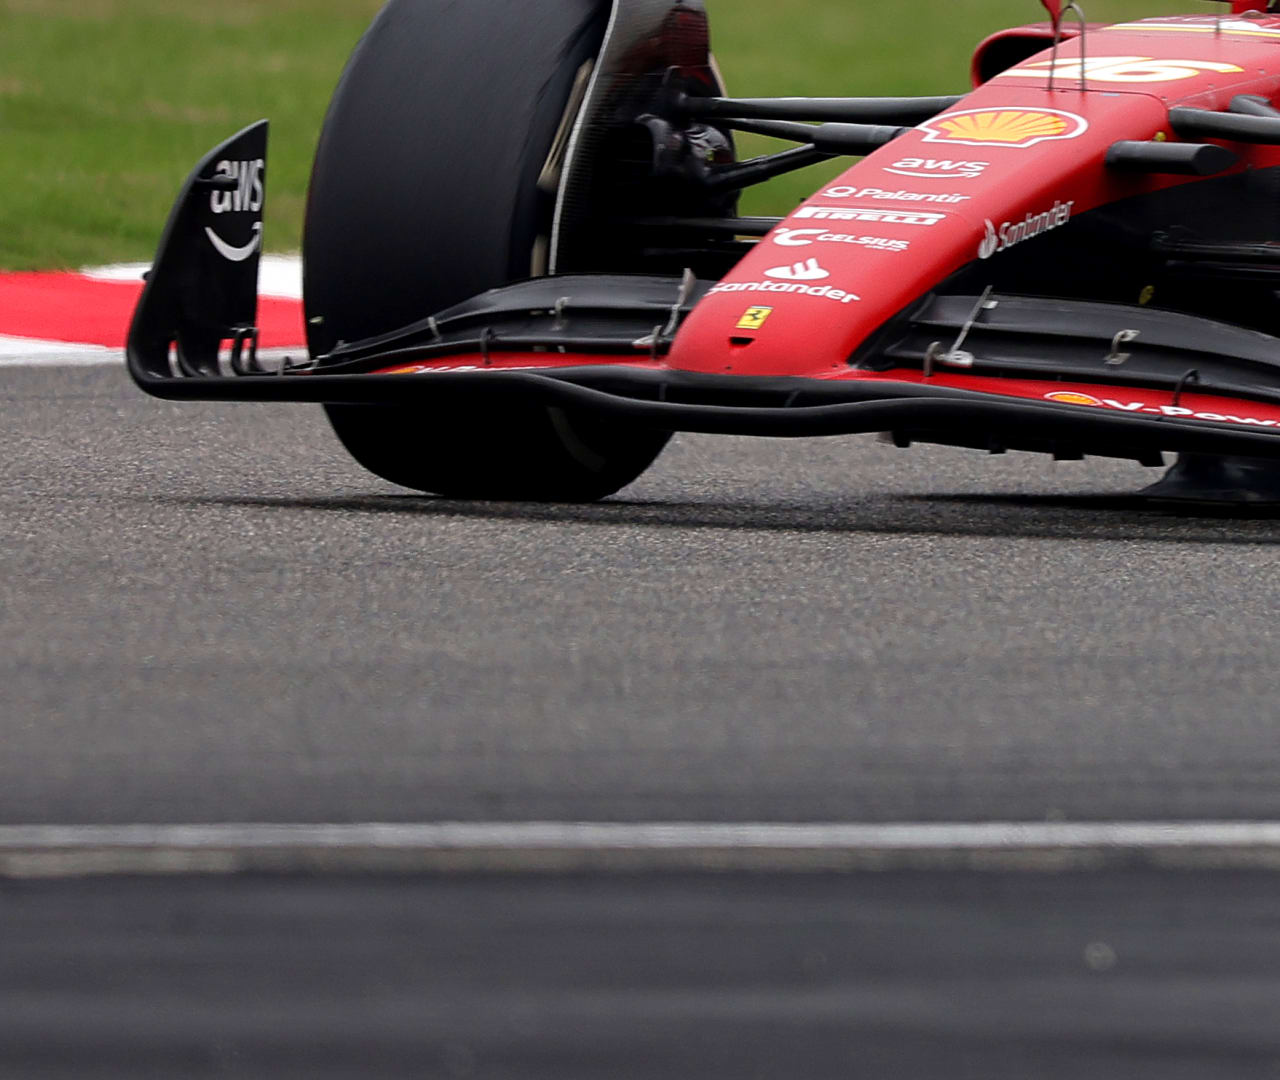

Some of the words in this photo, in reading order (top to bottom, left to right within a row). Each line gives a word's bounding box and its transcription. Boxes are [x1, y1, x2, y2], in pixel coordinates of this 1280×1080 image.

[892, 157, 990, 171] aws
[210, 159, 264, 214] aws
[854, 188, 971, 203] Palantir
[792, 206, 946, 226] PIRELLI
[996, 200, 1075, 252] Santander
[816, 230, 910, 250] CELSIUS
